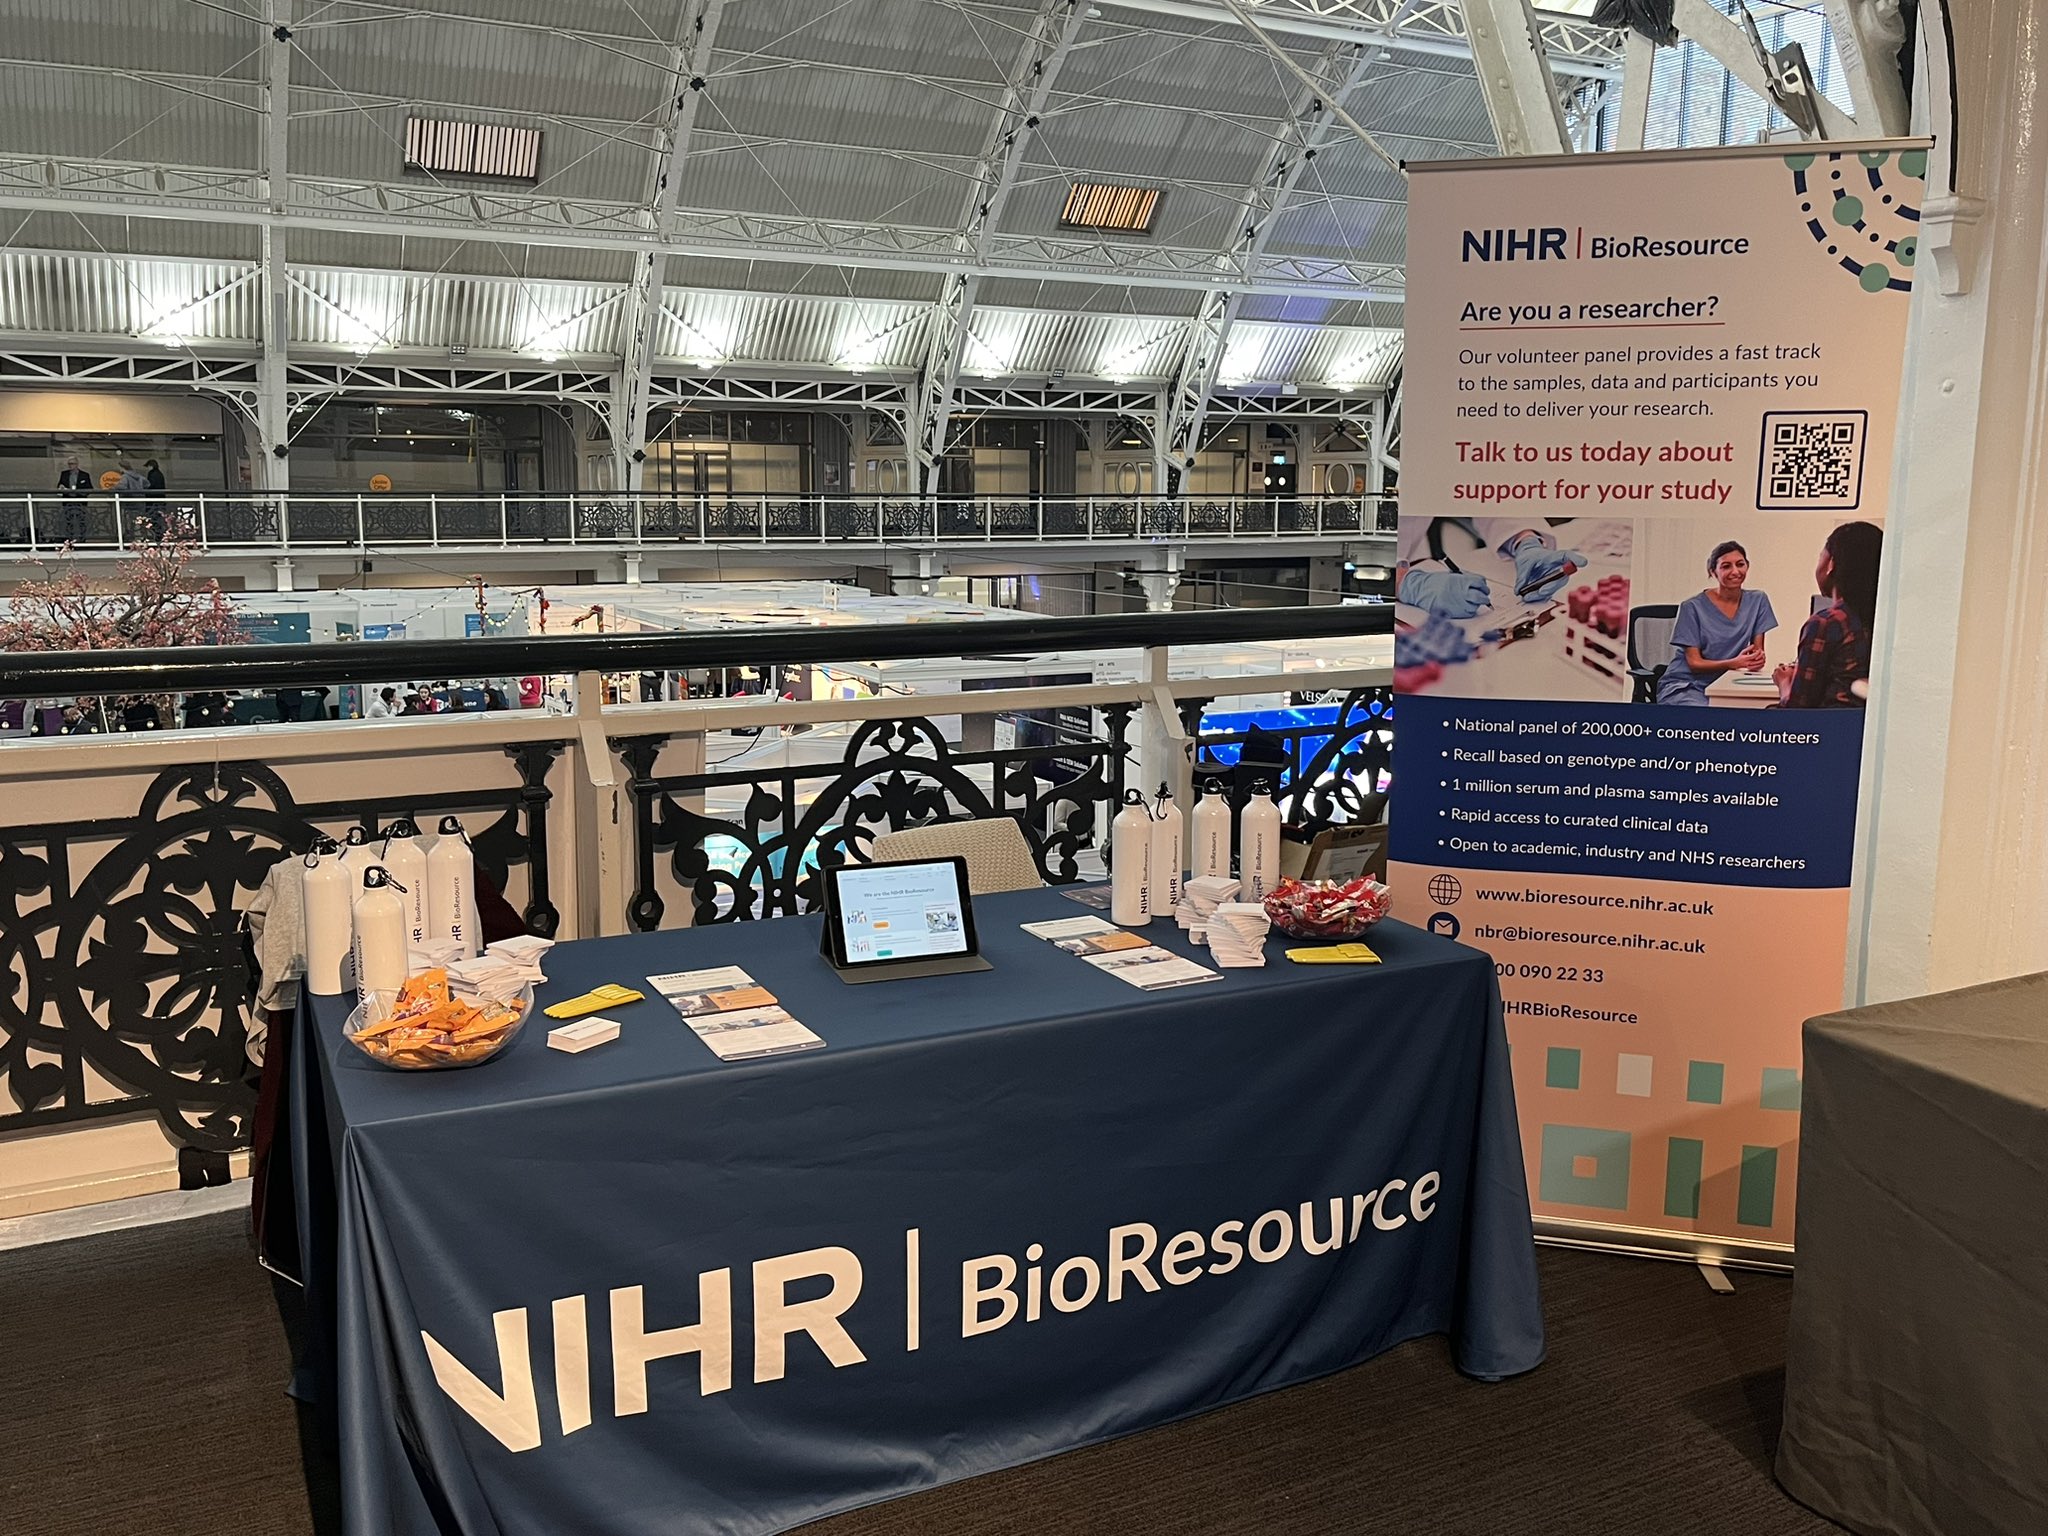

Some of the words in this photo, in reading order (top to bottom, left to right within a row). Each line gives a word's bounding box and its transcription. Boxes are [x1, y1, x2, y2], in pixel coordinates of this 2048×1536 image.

[1463, 228, 1566, 262] NIHR
[1592, 236, 1748, 258] BioResource
[1460, 302, 1501, 321] Are
[1509, 306, 1551, 325] you
[1559, 305, 1570, 319] a
[1579, 296, 1718, 319] researcher?
[1459, 350, 1492, 364] Our
[1497, 349, 1579, 363] volunteer
[1585, 347, 1631, 365] panel
[1637, 346, 1713, 365] provides
[1719, 349, 1728, 360] a
[1736, 344, 1769, 360] fast
[1776, 343, 1820, 359] track
[1459, 378, 1474, 390] to
[1481, 376, 1507, 390] the
[1513, 375, 1585, 393] samples,
[1592, 374, 1628, 389] data
[1635, 373, 1666, 388] and
[1673, 373, 1778, 391] participants
[1785, 375, 1817, 390] you
[1457, 402, 1497, 417] need
[1504, 403, 1520, 417] to
[1527, 402, 1584, 416] deliver
[1589, 405, 1628, 419] your
[1634, 400, 1713, 415] research.
[1455, 442, 1505, 462] Talk
[1513, 443, 1538, 462] to
[1547, 447, 1572, 461] us
[1580, 441, 1651, 466] today
[1659, 441, 1733, 461] about
[1454, 481, 1547, 503] support
[1555, 479, 1590, 499] for
[1597, 485, 1654, 503] your
[1661, 479, 1732, 504] study
[1300, 690, 1338, 704] VELSRA
[1456, 718, 1514, 732] National
[1519, 721, 1557, 735] panel
[1562, 722, 1577, 734] of
[1582, 722, 1652, 736] 200,000+
[1657, 729, 1734, 741] consented
[1740, 730, 1819, 743] volunteers
[1454, 748, 1494, 761] Recall
[1500, 750, 1540, 763] based
[1545, 755, 1563, 764] on
[1567, 755, 1636, 769] genotype
[1640, 757, 1691, 770] and/or
[1696, 759, 1776, 776] phenotype
[1453, 779, 1460, 790] 1
[1466, 780, 1511, 792] million
[1516, 785, 1559, 794] serum
[1564, 784, 1590, 795] and
[1595, 784, 1644, 798] plasma
[1650, 789, 1708, 803] samples
[1713, 792, 1778, 806] available
[1452, 808, 1490, 823] Rapid
[1495, 814, 1540, 824] access
[1545, 813, 1559, 824] to
[1564, 815, 1618, 827] curated
[1623, 816, 1671, 831] clinical
[1677, 820, 1708, 833] data
[1450, 838, 1488, 852] Open
[1493, 841, 1507, 852] to
[1512, 842, 1581, 857] academic,
[1586, 844, 1644, 861] industry
[1649, 850, 1675, 861] and
[1681, 851, 1714, 864] NHS
[1720, 856, 1805, 869] researchers
[1476, 889, 1713, 915] www.bioresource.nihr.ac.uk
[413, 928, 422, 942] HR
[452, 924, 462, 941] HR
[1475, 924, 1705, 953] nbr@bioresource.nihr.ac.uk
[1520, 965, 1551, 978] 090
[1557, 967, 1577, 980] 22
[1583, 969, 1604, 982] 33
[421, 1246, 867, 1453] NIHR
[962, 1171, 1440, 1338] BioResource
